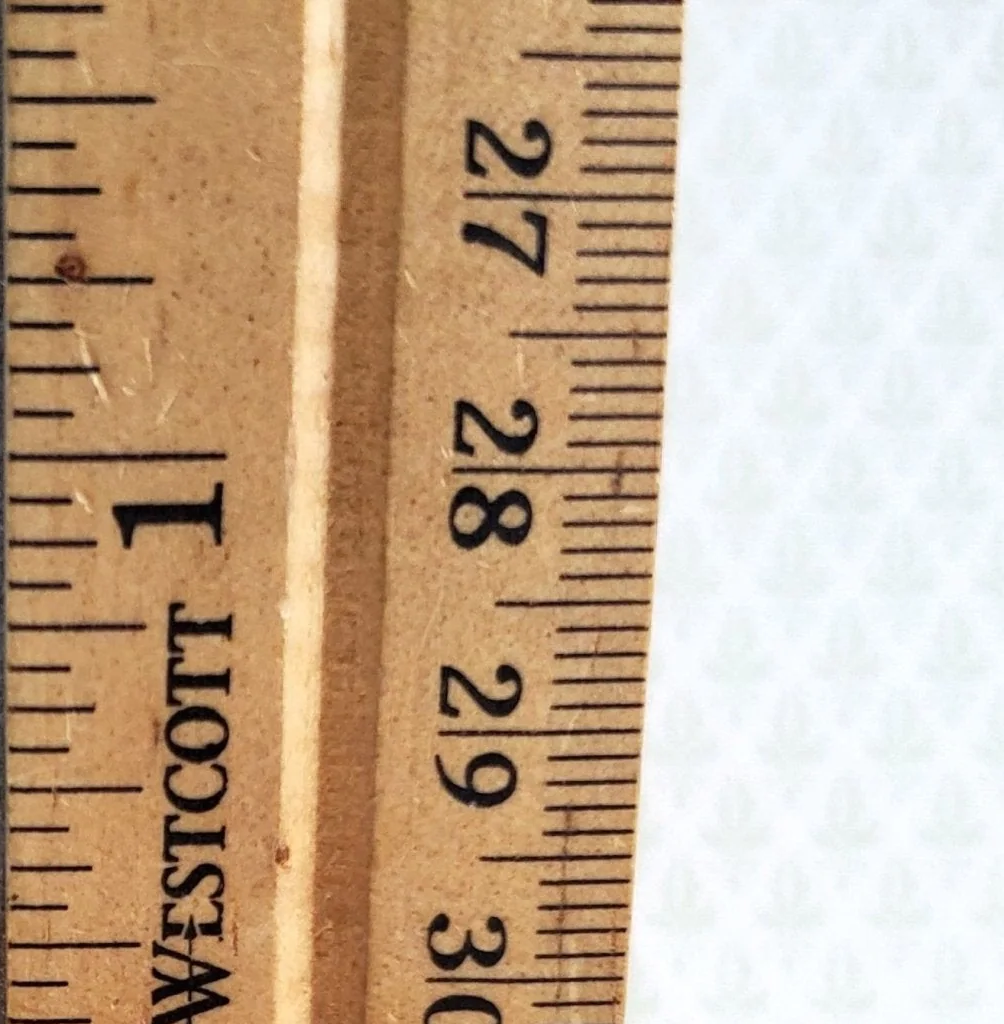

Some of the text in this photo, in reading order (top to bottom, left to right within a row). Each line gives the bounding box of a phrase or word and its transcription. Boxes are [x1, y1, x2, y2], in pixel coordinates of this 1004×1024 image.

[461, 118, 553, 278] 27
[112, 482, 224, 550] 1
[448, 399, 539, 551] 28
[434, 663, 523, 809] 29
